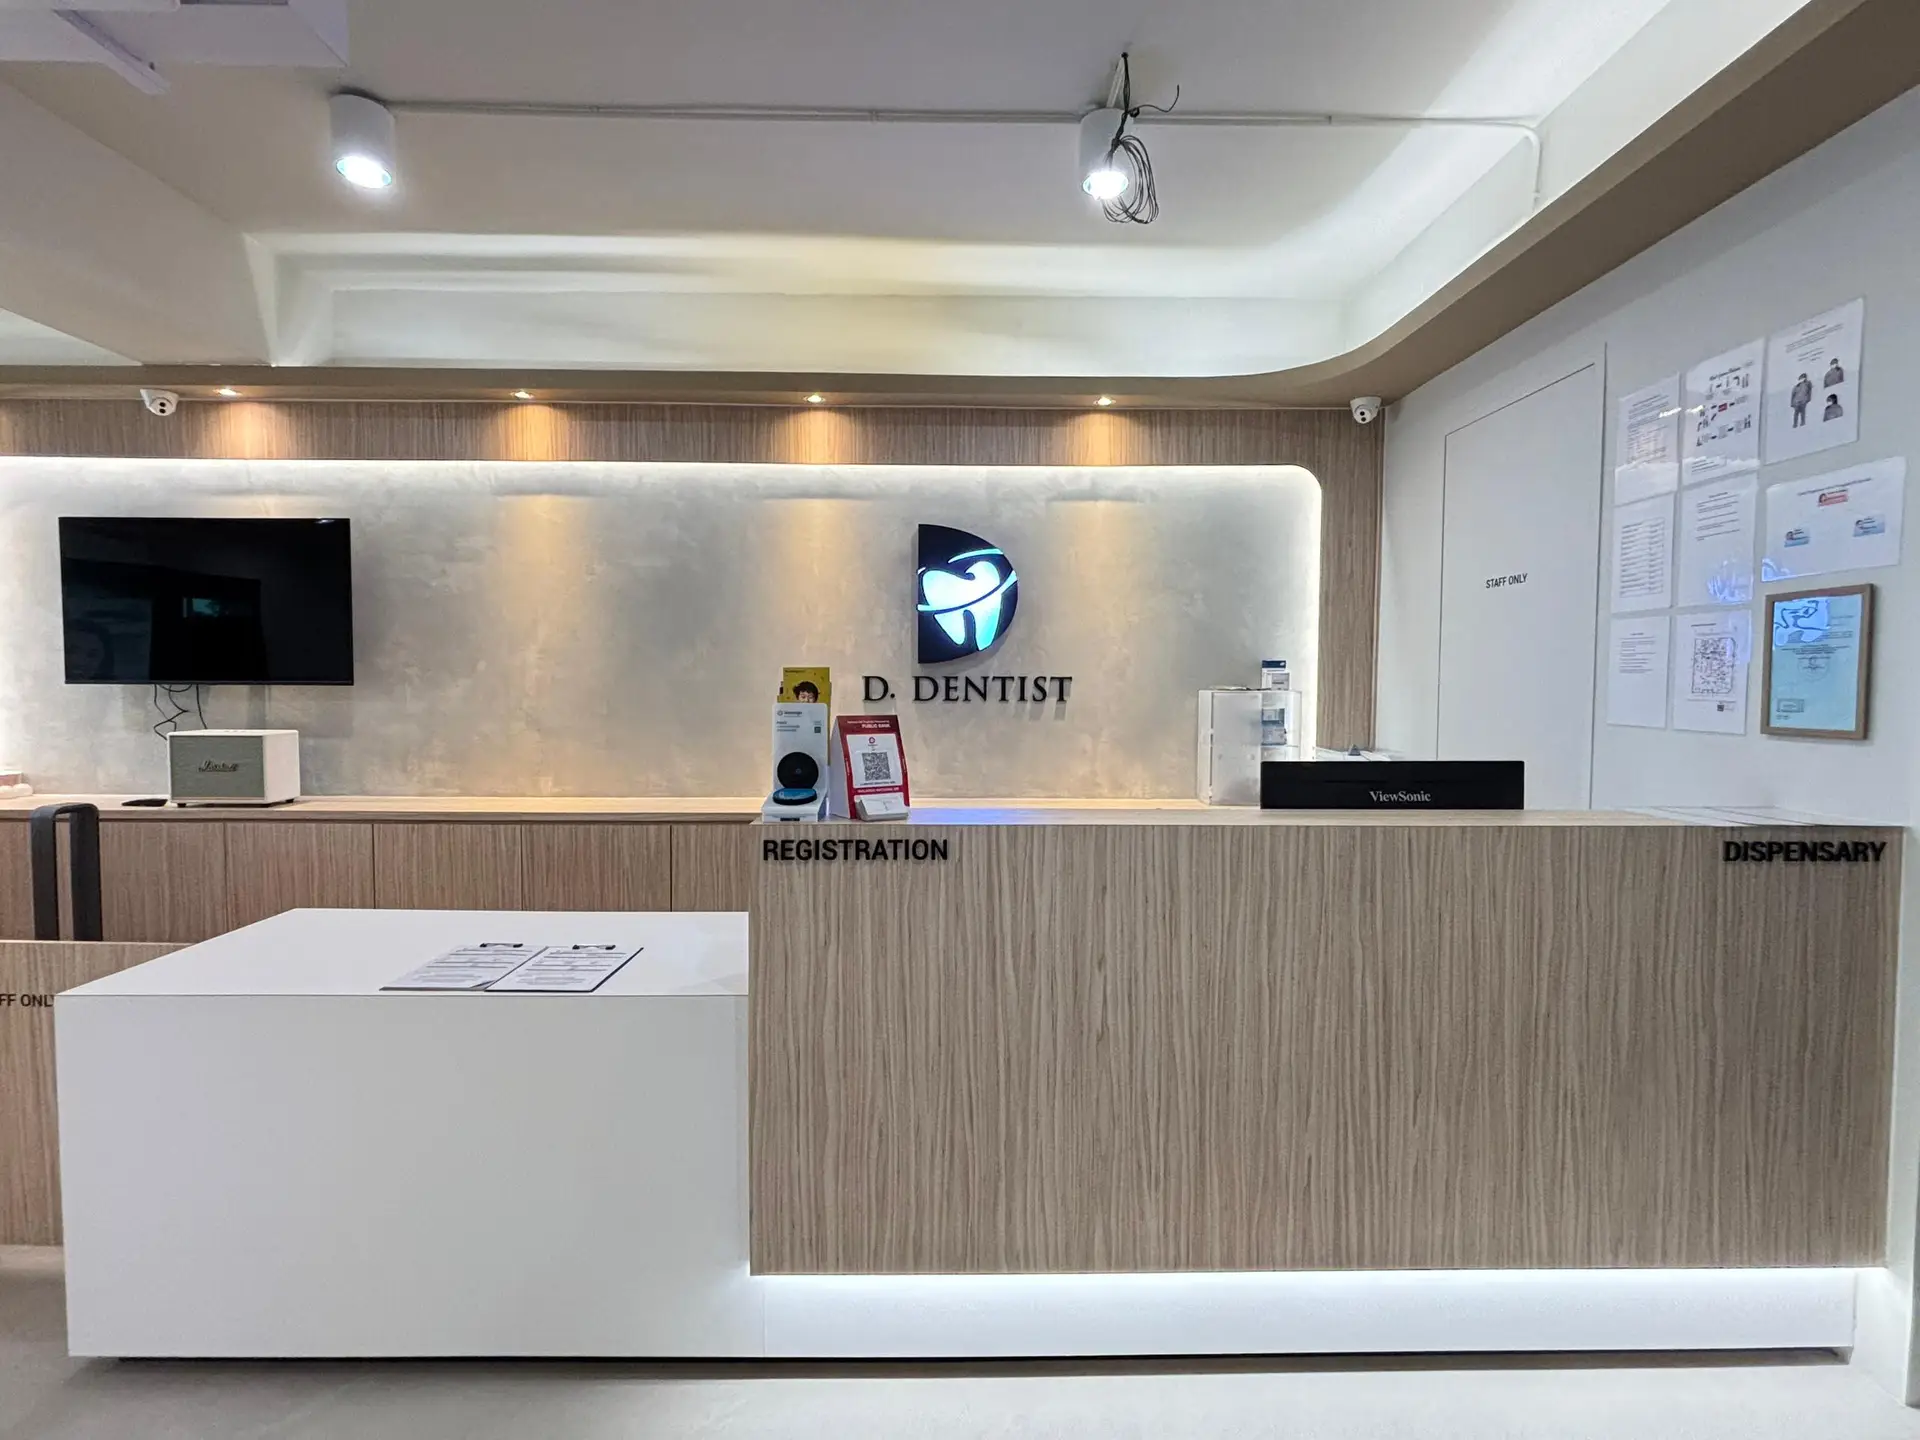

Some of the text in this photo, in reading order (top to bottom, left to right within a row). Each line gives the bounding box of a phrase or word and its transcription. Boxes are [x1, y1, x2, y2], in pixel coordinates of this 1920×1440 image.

[1486, 573, 1528, 589] STAFF ONLY
[862, 676, 1073, 702] D. DENTIST
[1369, 790, 1432, 802] ViewSonic
[763, 839, 948, 861] REGISTRATION
[1723, 841, 1887, 862] DISPENSARY
